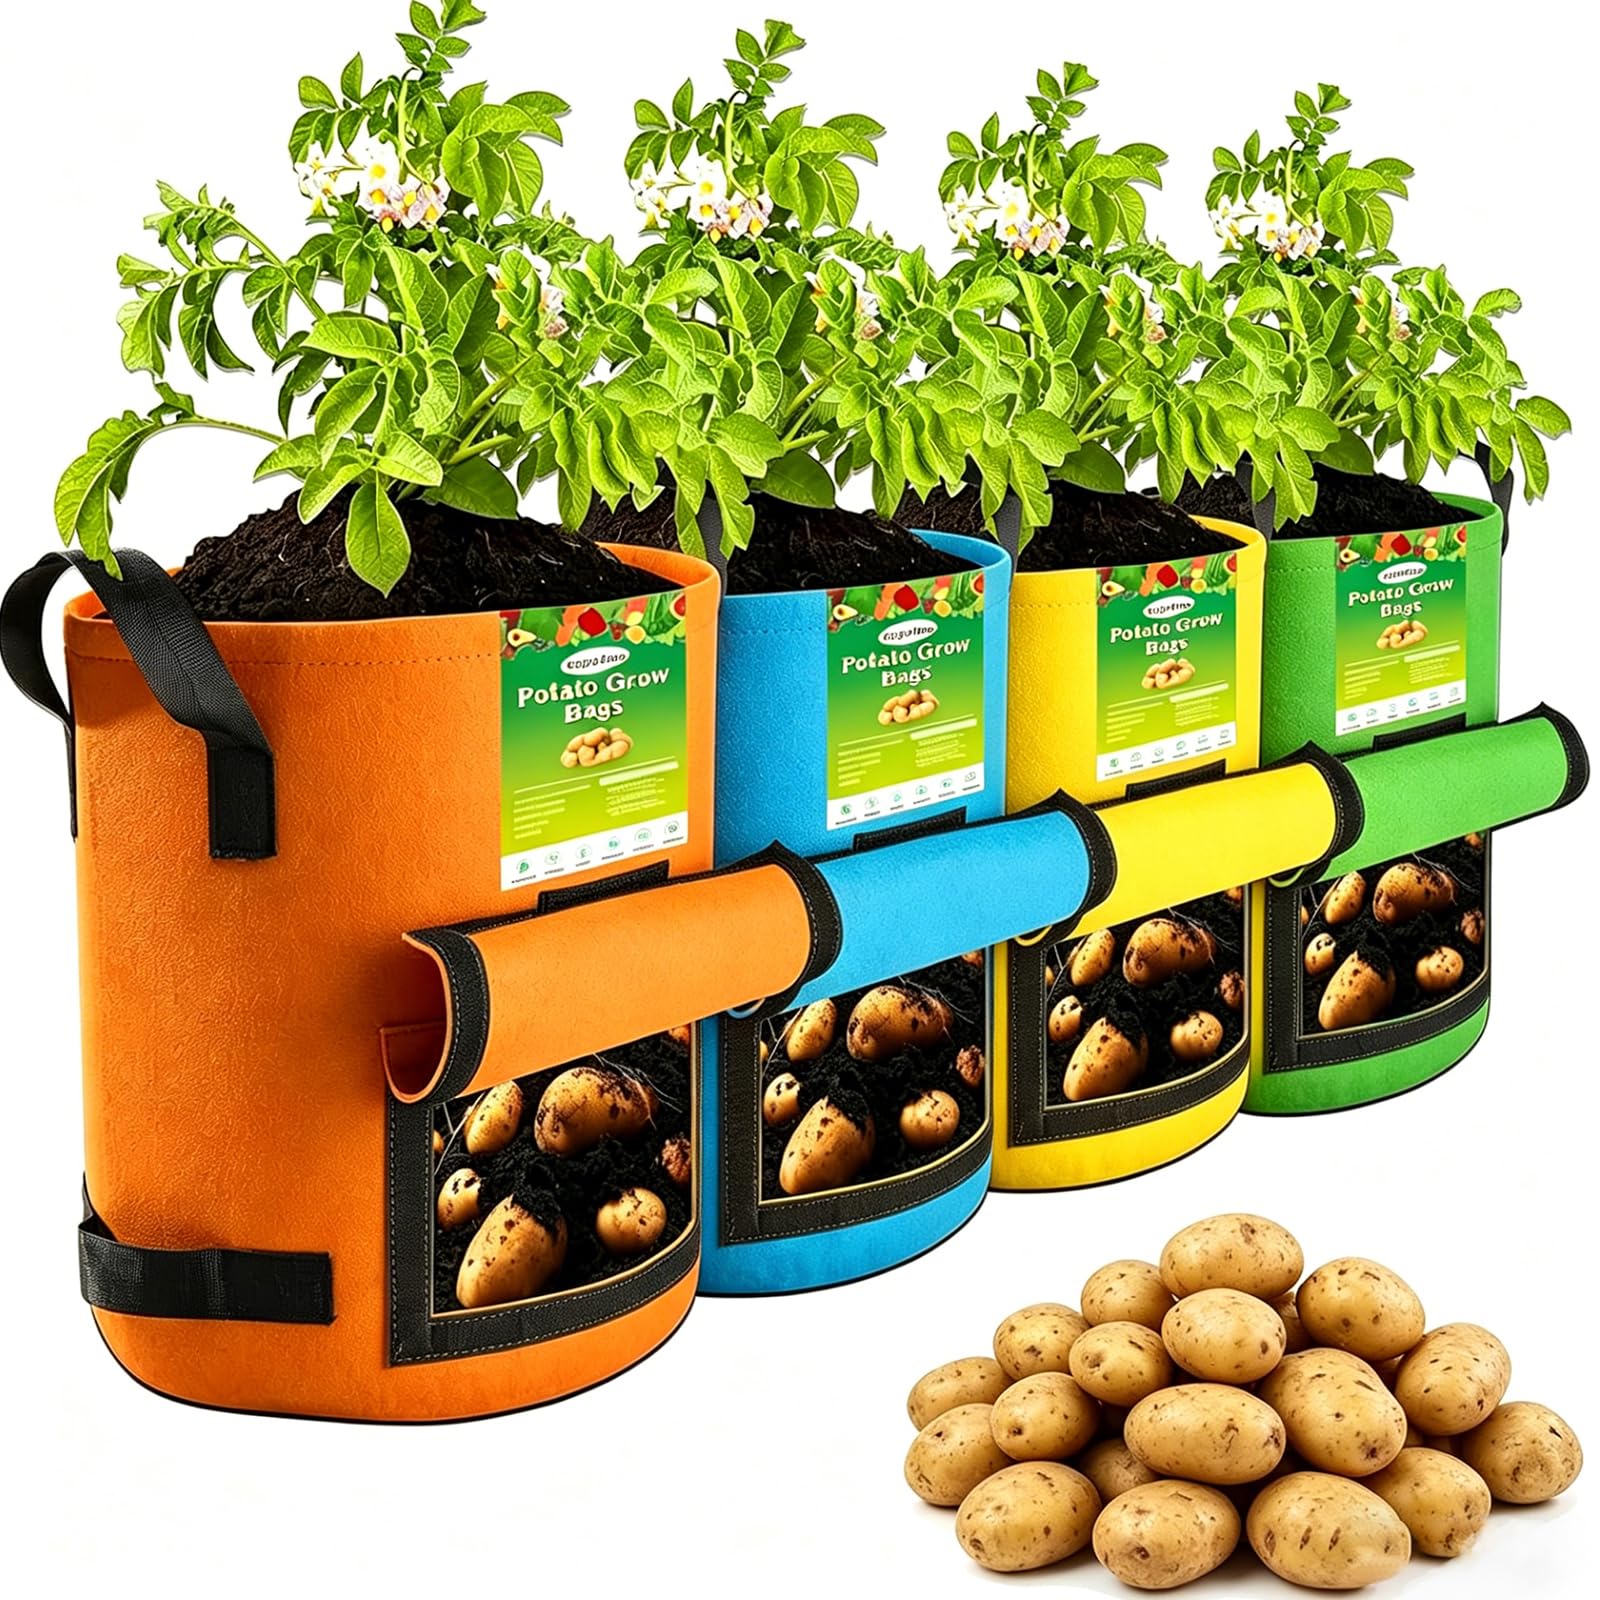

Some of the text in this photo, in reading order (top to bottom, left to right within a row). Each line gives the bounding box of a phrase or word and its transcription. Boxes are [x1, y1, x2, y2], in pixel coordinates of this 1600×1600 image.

[1110, 612, 1224, 643] Potato Grow
[841, 638, 971, 674] Potato Grow
[517, 667, 670, 708] Potato Grow
[881, 665, 933, 688] Bags
[564, 699, 624, 724] Bags
